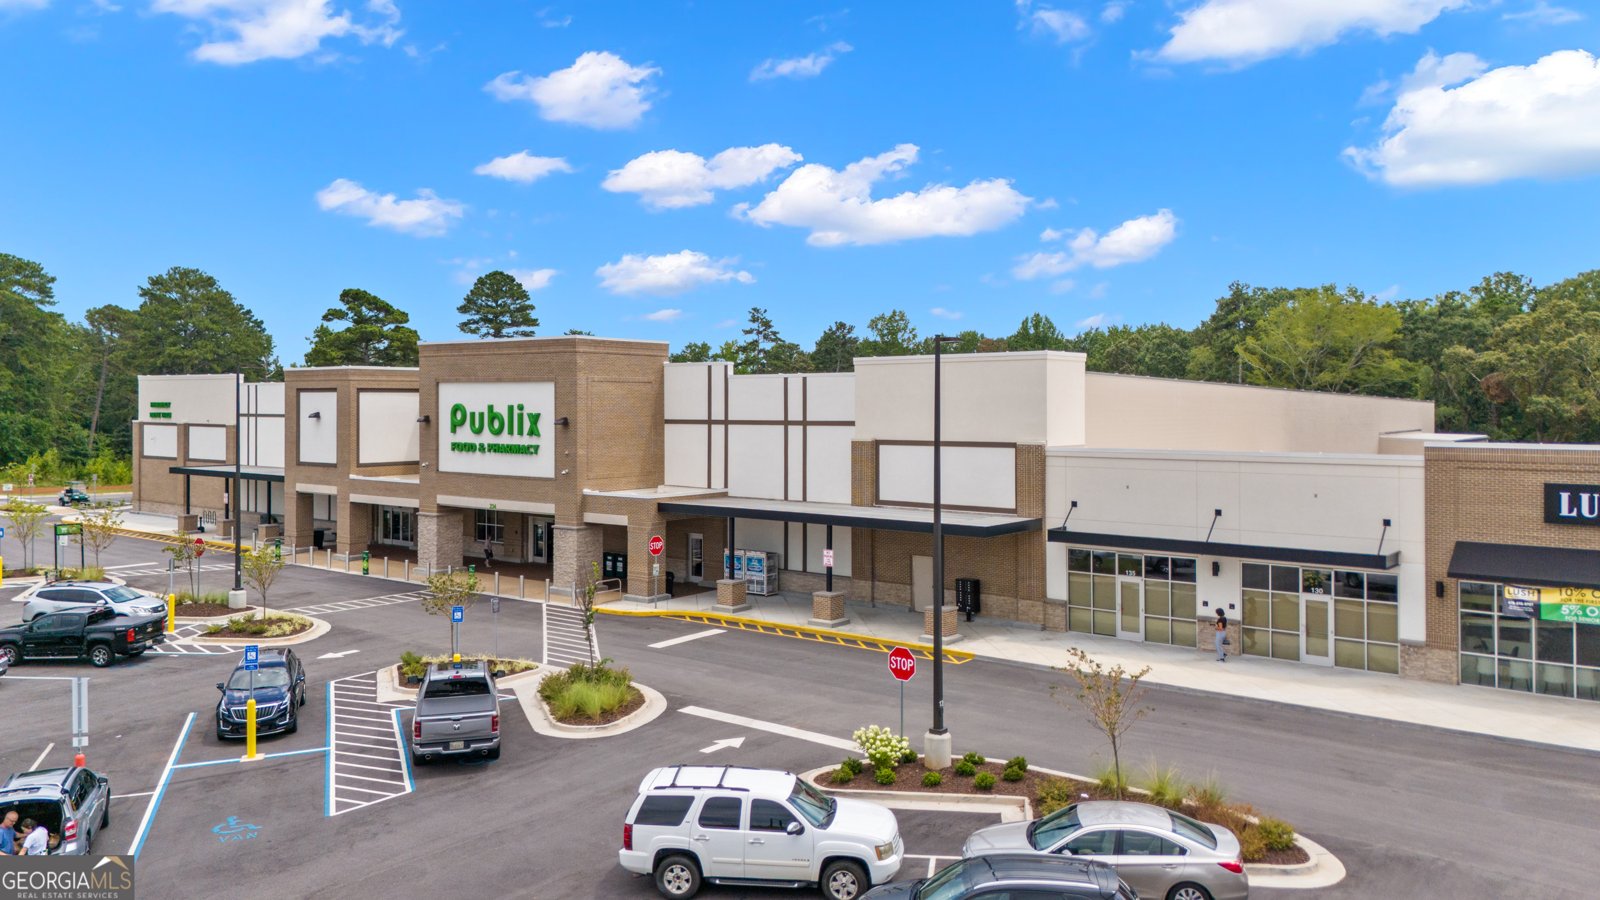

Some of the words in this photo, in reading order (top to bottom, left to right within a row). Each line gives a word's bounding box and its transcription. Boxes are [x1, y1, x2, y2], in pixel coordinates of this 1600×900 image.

[450, 402, 541, 437] Publix
[450, 441, 477, 453] FOOD
[478, 442, 486, 454] &
[487, 443, 540, 455] PHARMACY
[1559, 492, 1600, 518] LU
[649, 541, 663, 550] STOP
[1507, 587, 1536, 597] LUSH
[1559, 586, 1587, 598] 10%
[1560, 604, 1583, 616] 5%
[890, 655, 914, 671] STOP
[217, 831, 258, 843] VAN
